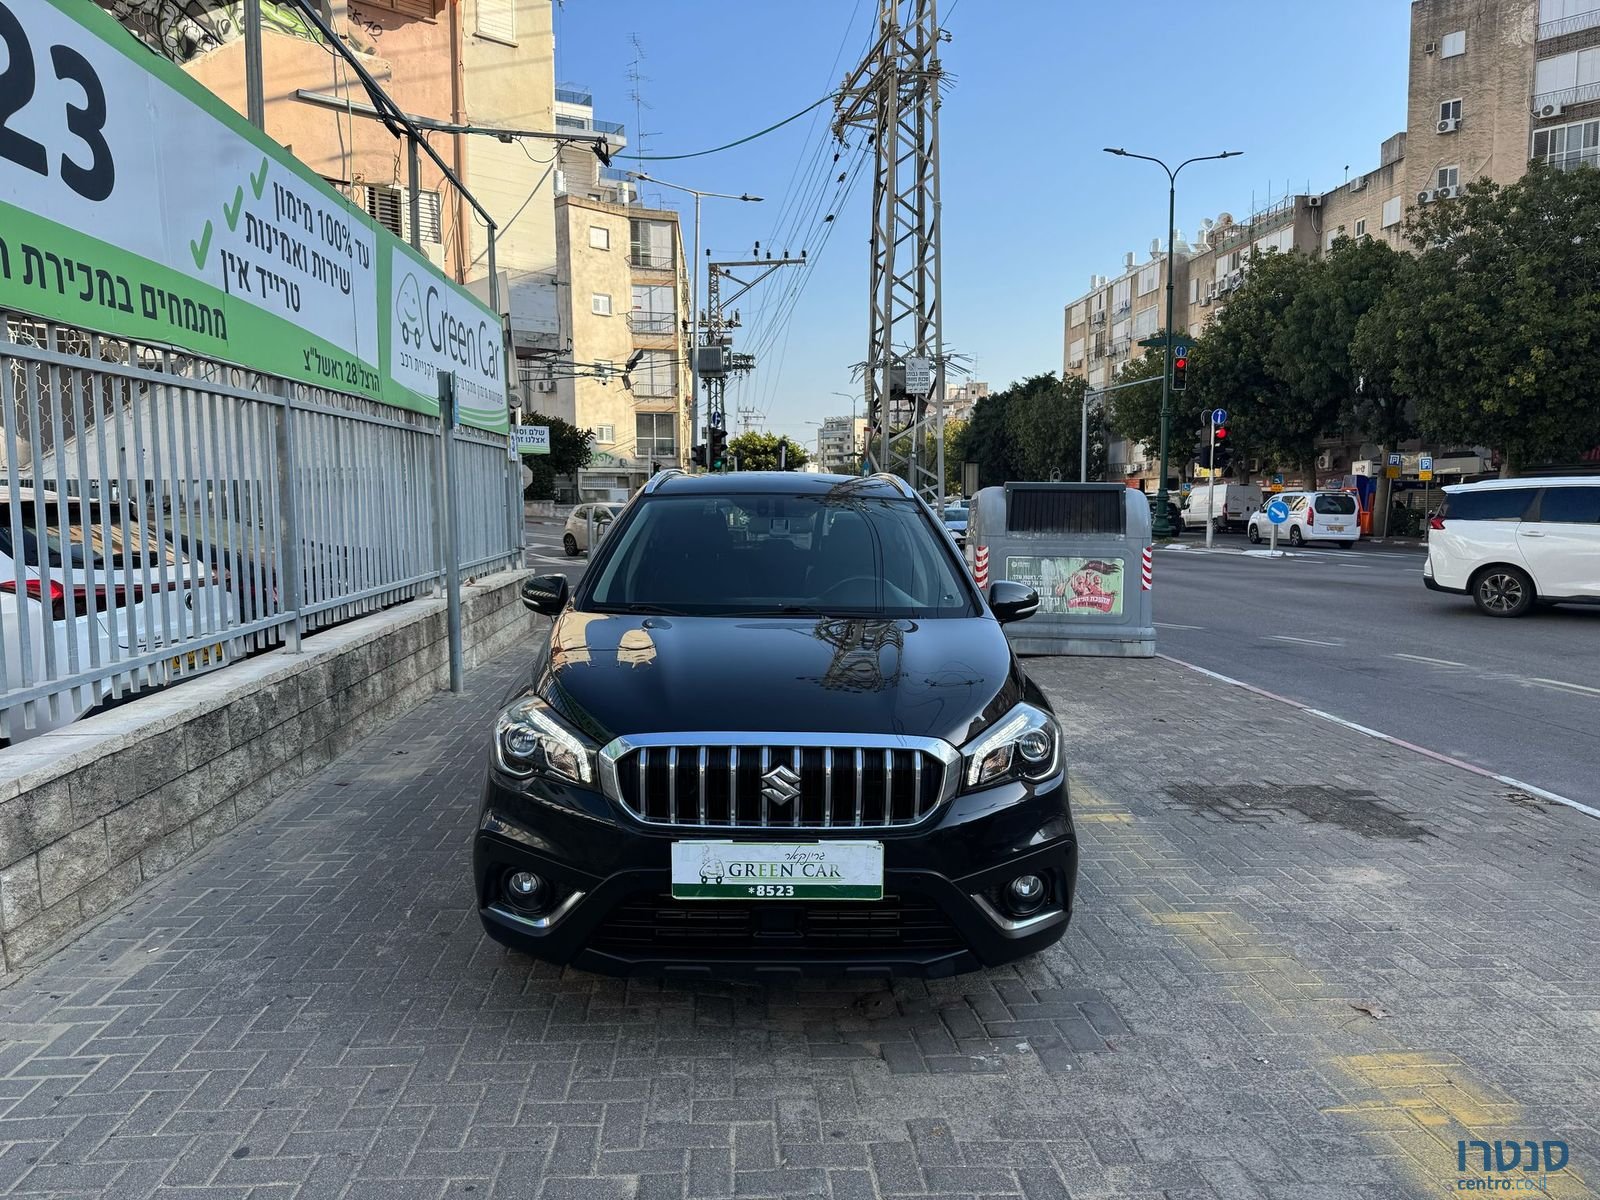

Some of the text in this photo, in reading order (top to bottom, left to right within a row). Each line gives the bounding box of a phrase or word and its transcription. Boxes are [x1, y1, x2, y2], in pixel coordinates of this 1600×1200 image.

[273, 181, 369, 270] עד 100% מימון
[244, 211, 350, 295] שירות ואמינות
[20, 243, 134, 314] במכירת
[220, 248, 300, 313] טרייד אין
[140, 283, 228, 340] מתמחים
[427, 285, 500, 381] Green Car
[345, 360, 358, 385] 28
[359, 364, 380, 392] הרצל
[400, 352, 413, 370] רכב
[526, 436, 546, 444] אצלנו
[529, 428, 545, 436] שלם
[728, 862, 841, 878] GREEN CAR
